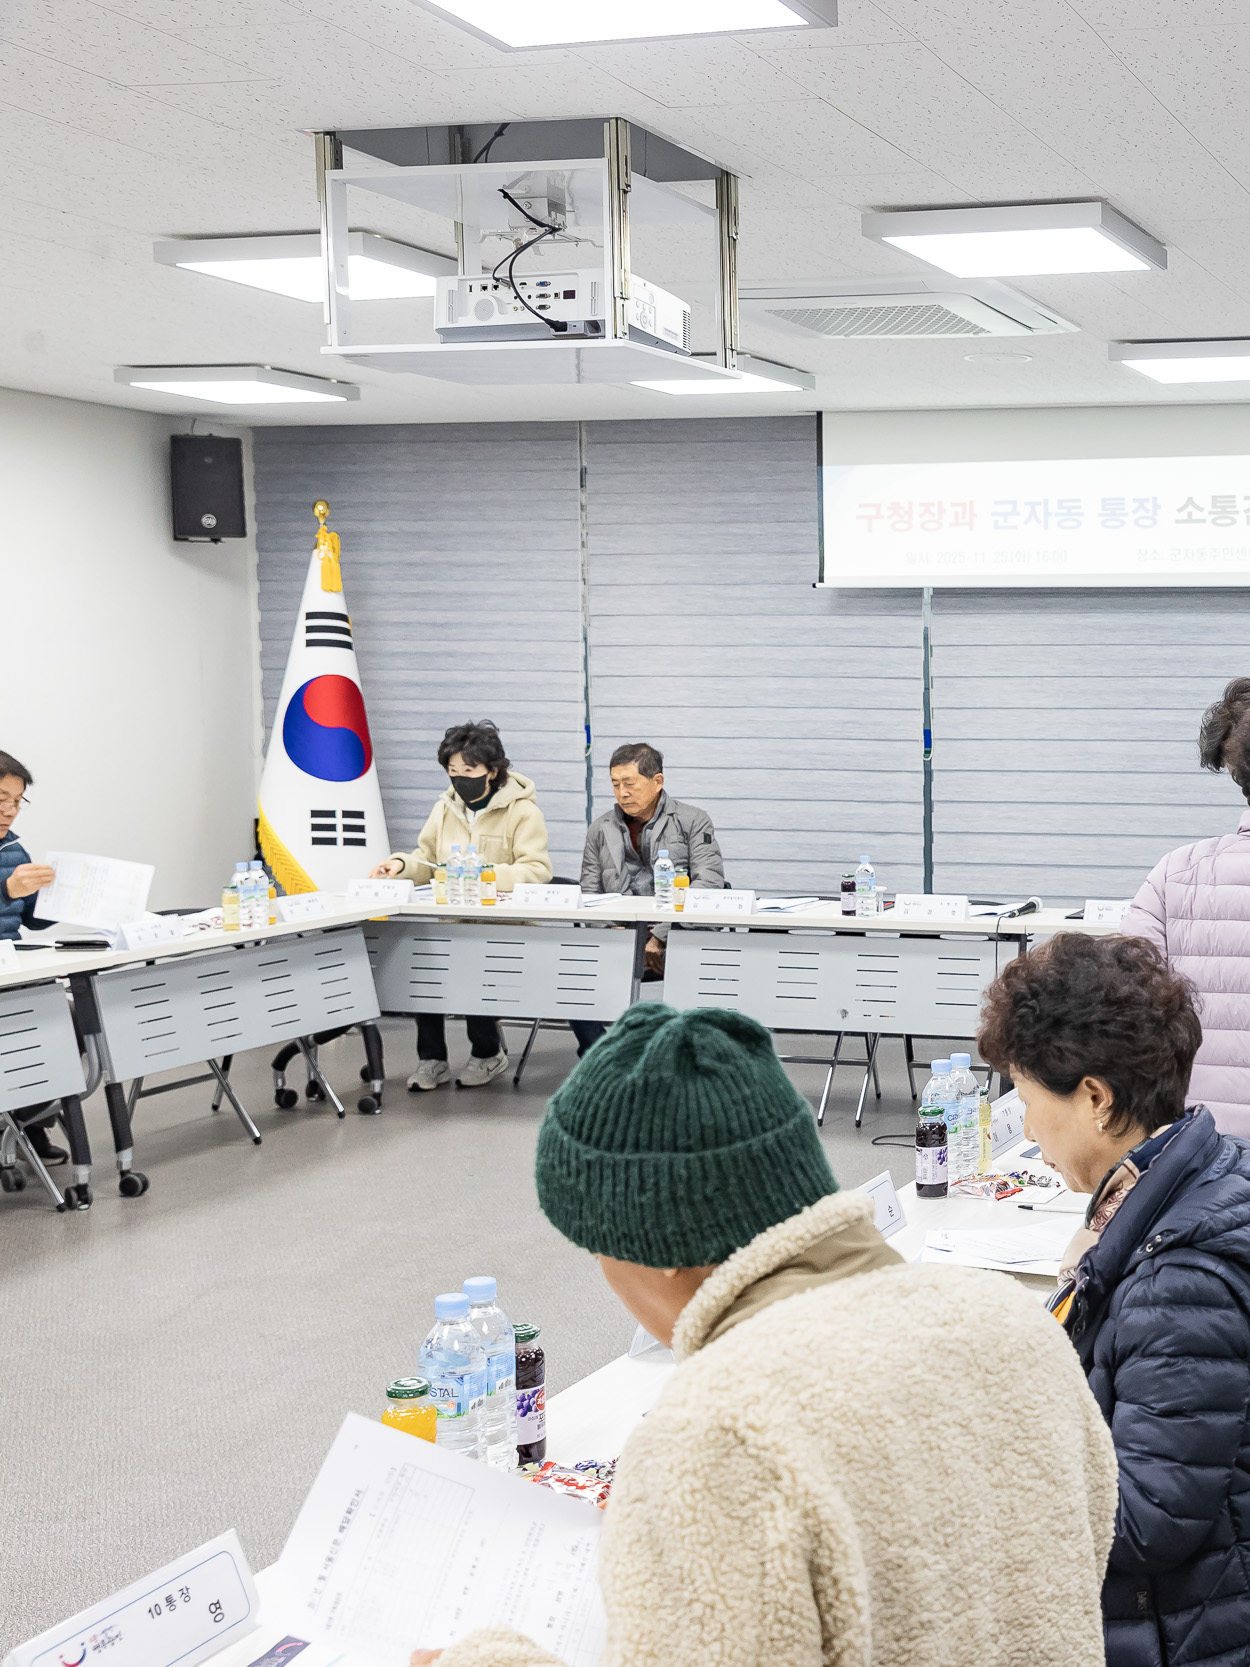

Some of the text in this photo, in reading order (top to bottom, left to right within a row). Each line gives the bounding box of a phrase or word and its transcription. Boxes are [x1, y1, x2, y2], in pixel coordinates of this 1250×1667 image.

[855, 499, 977, 533] 구청장과
[990, 498, 1085, 531] 군자동
[1097, 495, 1162, 529] 통장
[1035, 549, 1068, 563] 16:00
[430, 1387, 459, 1398] STAL
